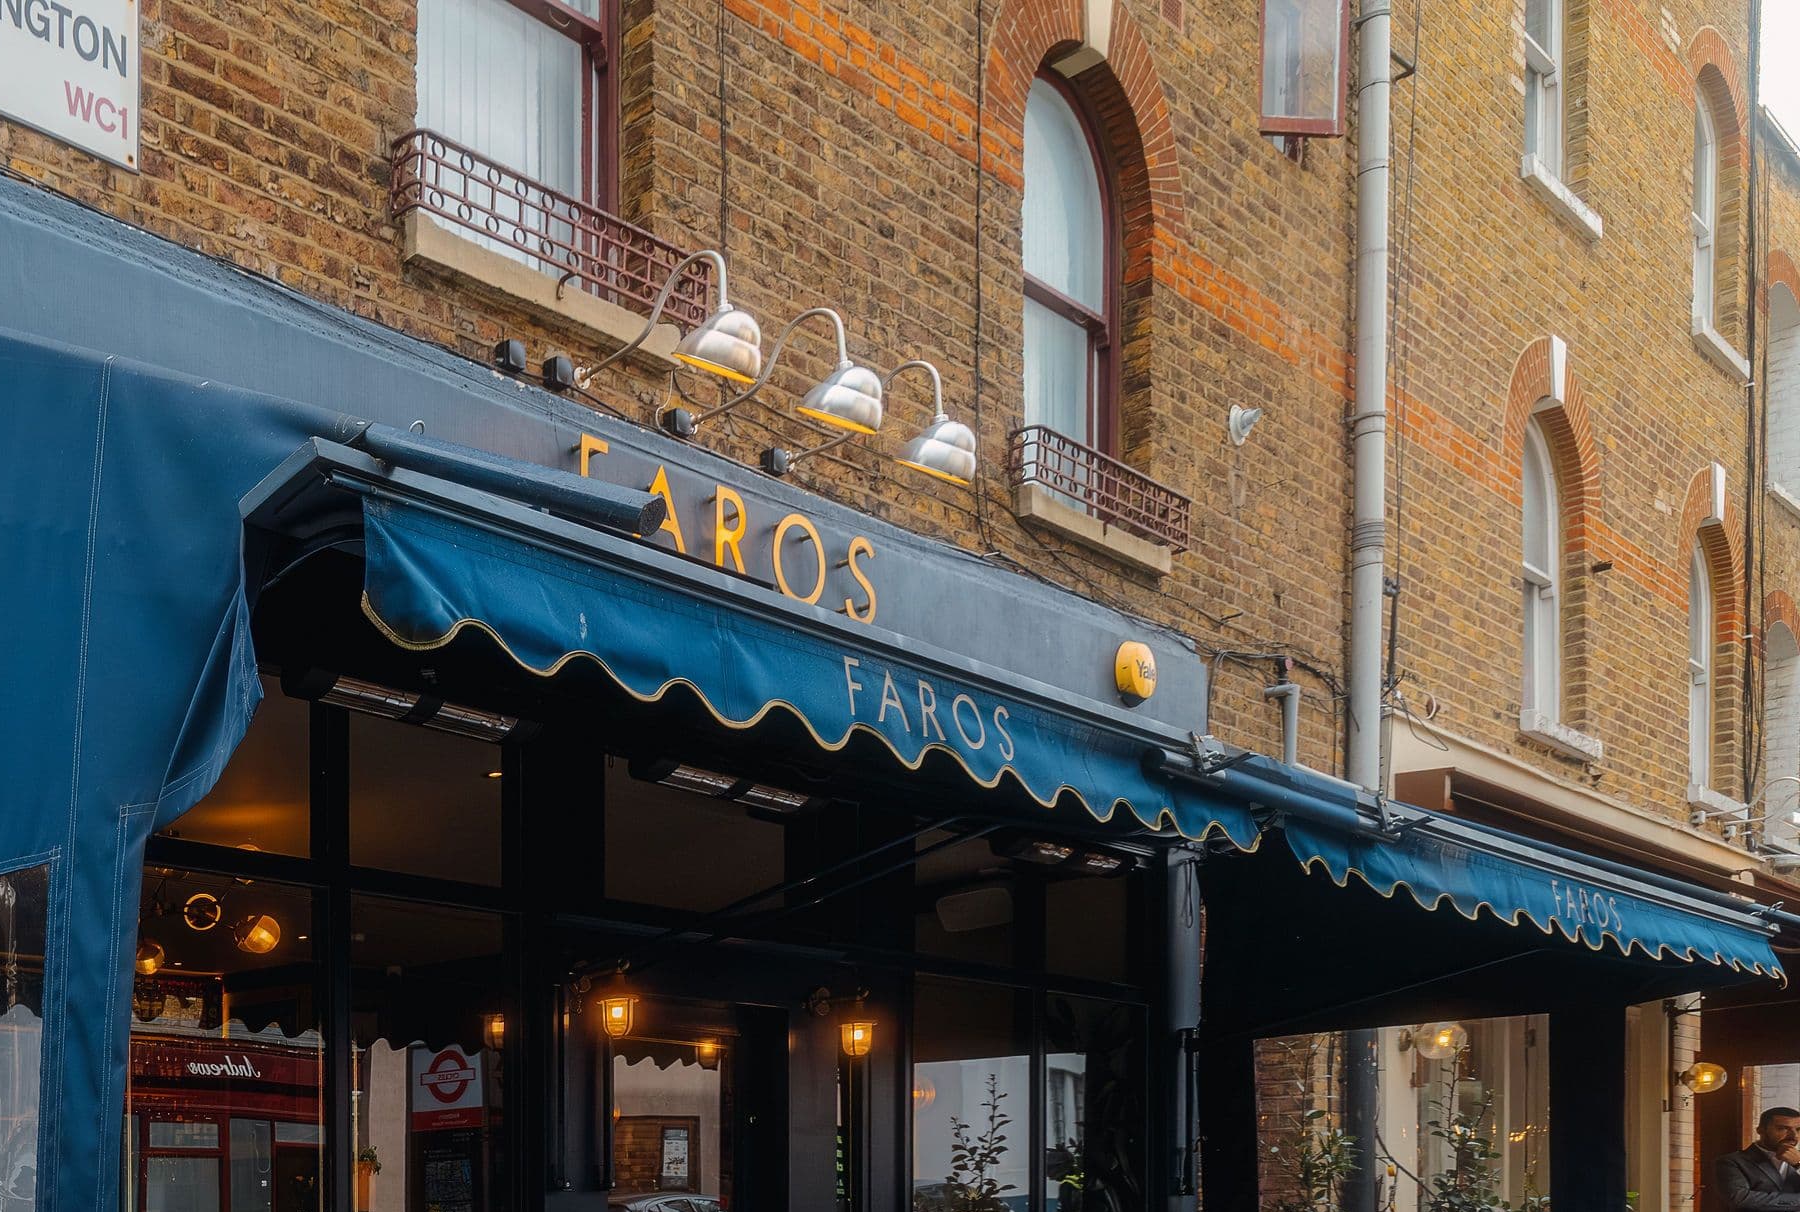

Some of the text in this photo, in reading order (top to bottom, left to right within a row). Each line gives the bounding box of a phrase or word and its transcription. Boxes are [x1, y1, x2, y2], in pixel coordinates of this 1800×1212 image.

[63, 80, 128, 140] WC1
[843, 655, 1015, 762] FAROS
[1551, 880, 1622, 932] FAROS
